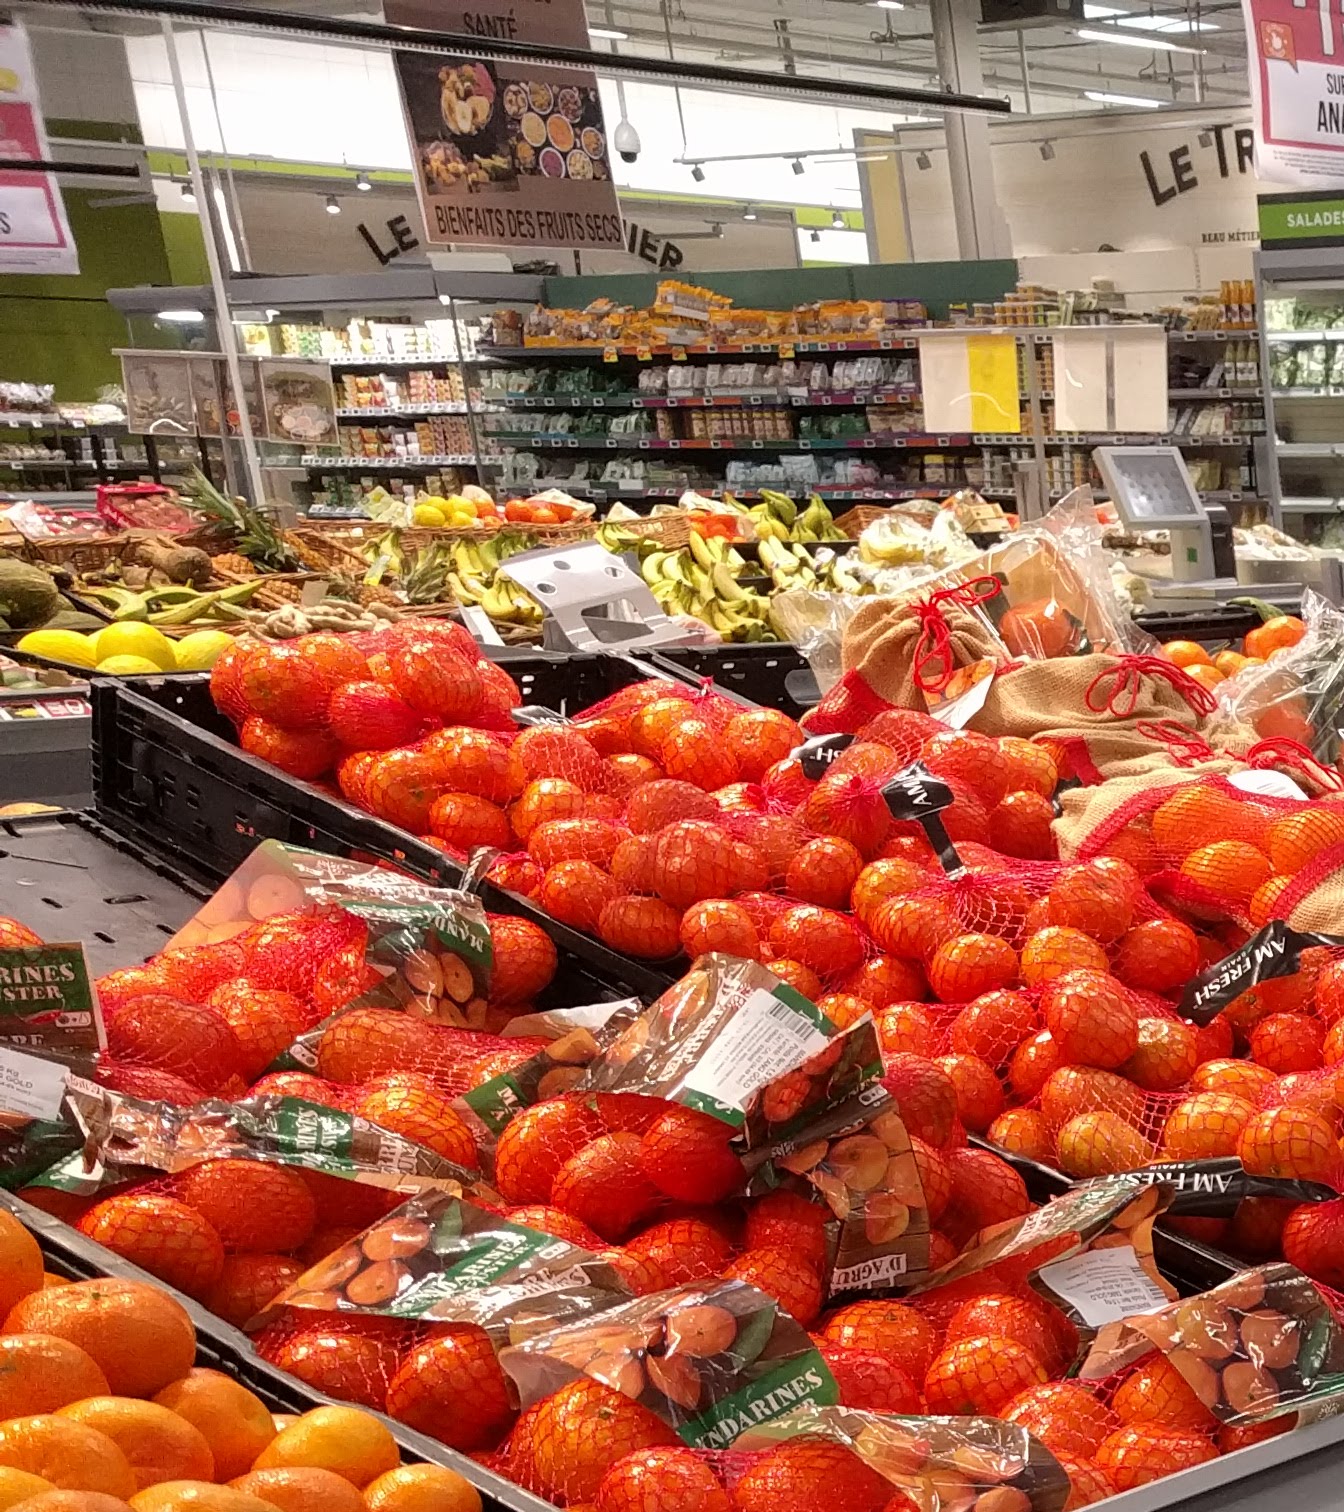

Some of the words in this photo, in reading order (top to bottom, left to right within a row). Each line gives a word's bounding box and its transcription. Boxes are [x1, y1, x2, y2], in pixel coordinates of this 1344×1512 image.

[1140, 145, 1199, 207] LE
[357, 215, 420, 266] LE
[435, 204, 504, 238] BIENFAITS
[507, 210, 535, 239] DES
[536, 211, 585, 242] FRUITS
[585, 214, 623, 243] SECS
[1201, 231, 1227, 244] BEAU
[1240, 937, 1287, 966] AM
[4, 984, 65, 1002] STER
[1194, 956, 1245, 1007] FRESH
[1193, 1170, 1234, 1193] AM
